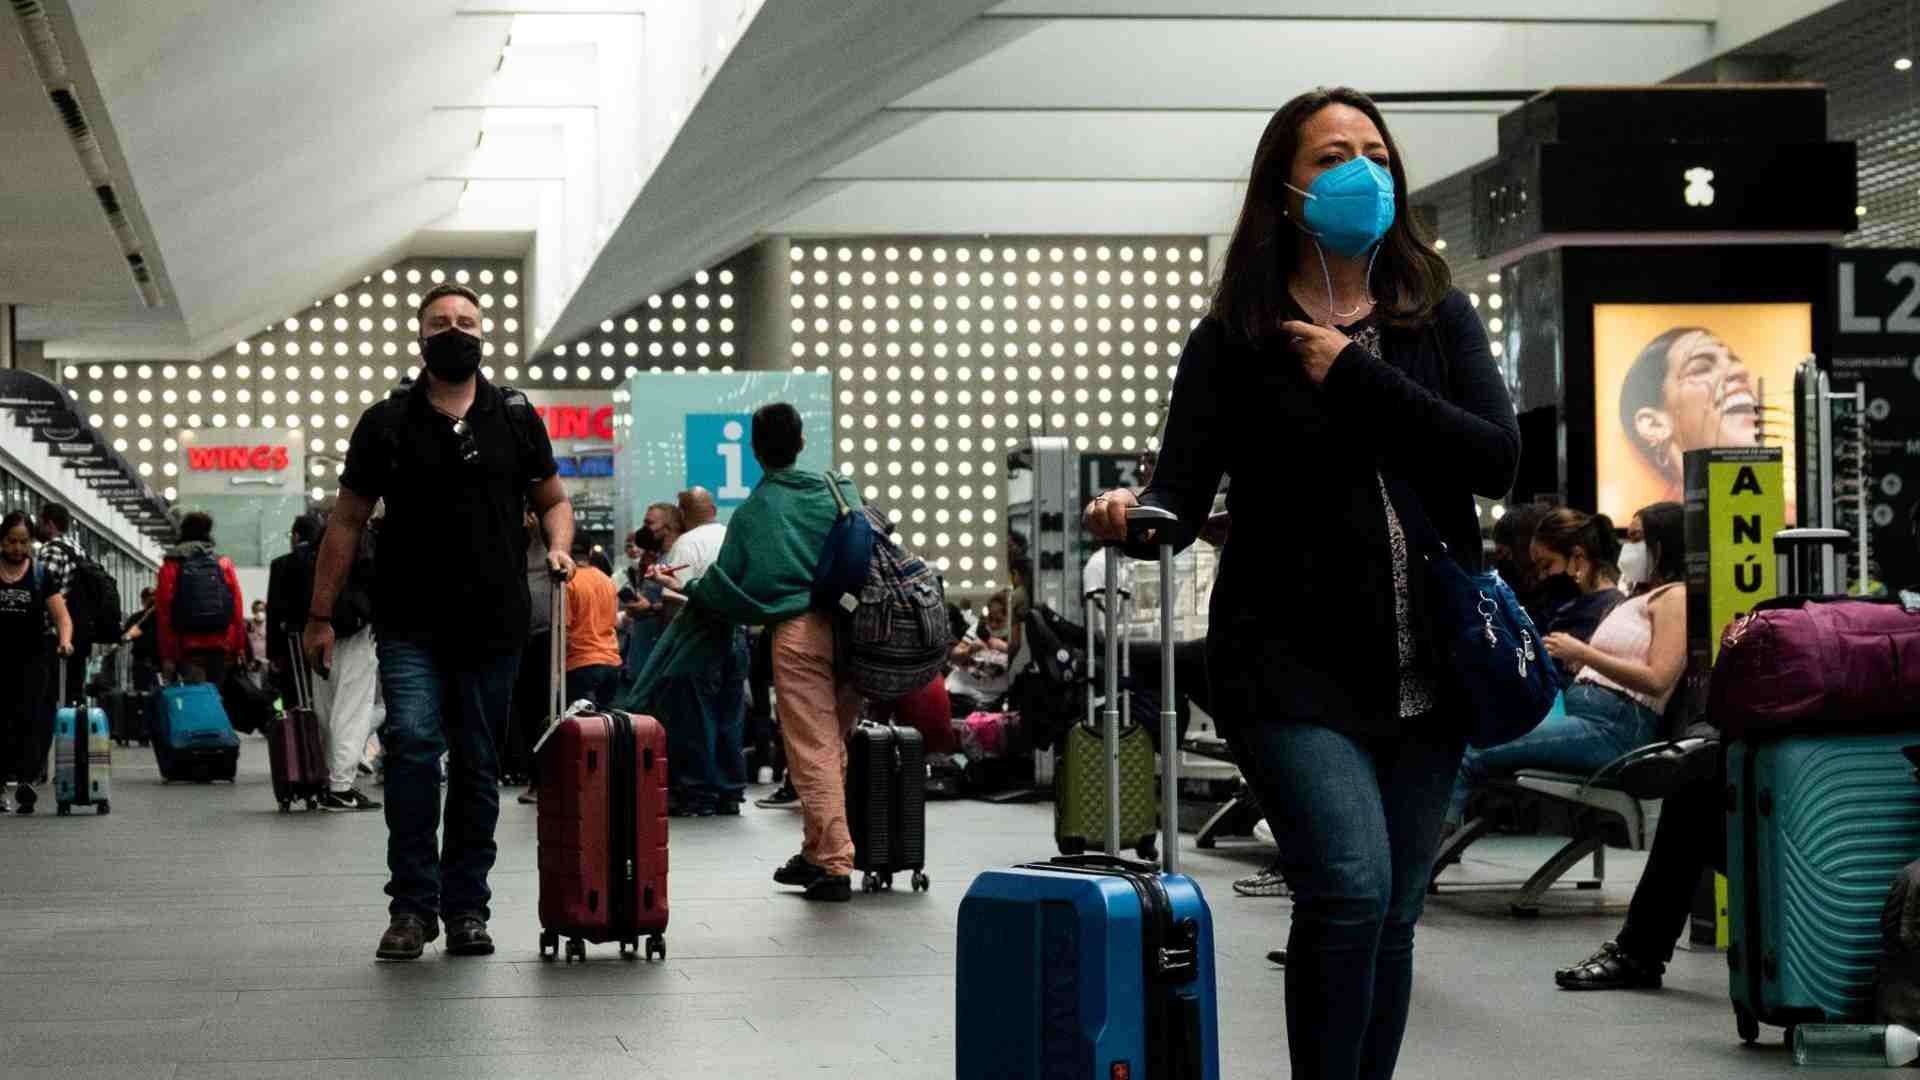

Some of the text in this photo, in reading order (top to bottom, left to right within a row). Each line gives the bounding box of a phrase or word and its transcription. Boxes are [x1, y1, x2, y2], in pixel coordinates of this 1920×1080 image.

[1838, 261, 1920, 333] L2
[535, 404, 614, 439] ING
[188, 446, 289, 470] WINGS
